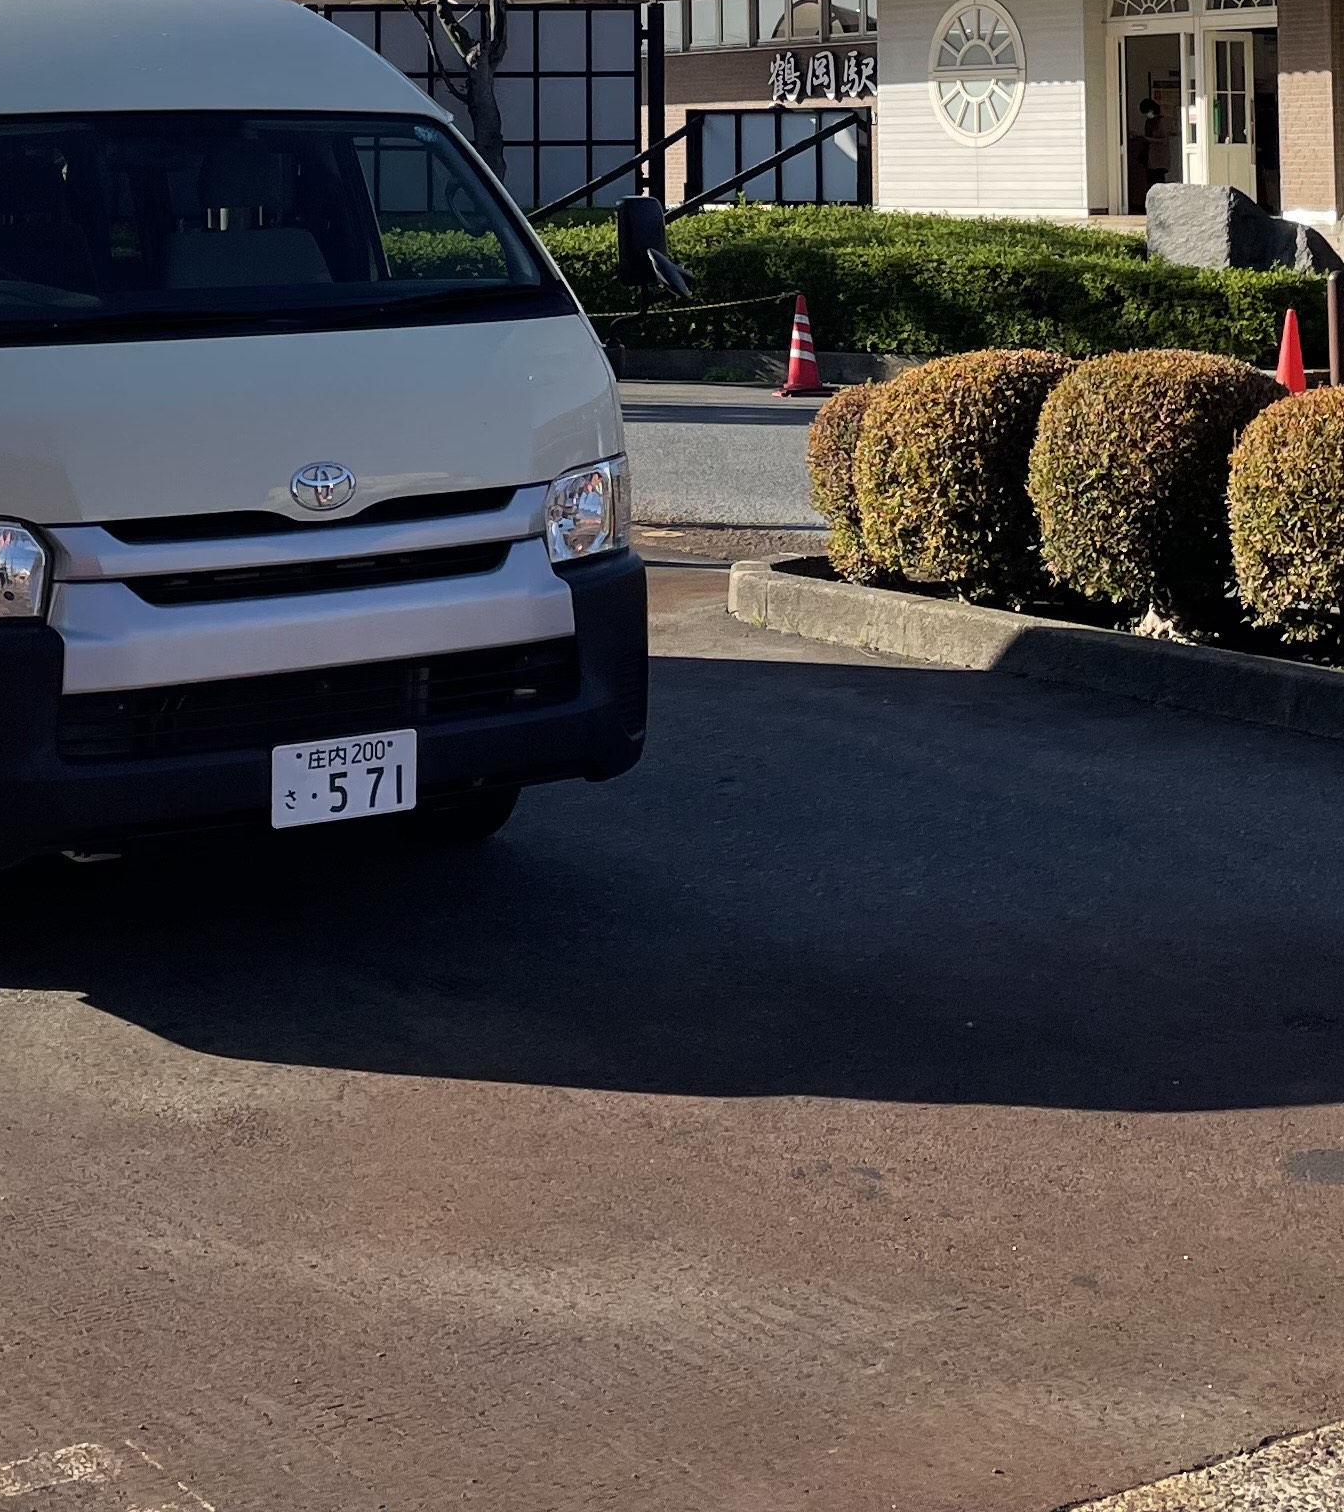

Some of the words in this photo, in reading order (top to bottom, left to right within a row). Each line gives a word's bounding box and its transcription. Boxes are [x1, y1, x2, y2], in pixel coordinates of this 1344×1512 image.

[769, 50, 877, 102] 鶴岡駅
[307, 746, 347, 770] 庄内
[351, 740, 386, 764] 200
[284, 789, 297, 810] さ
